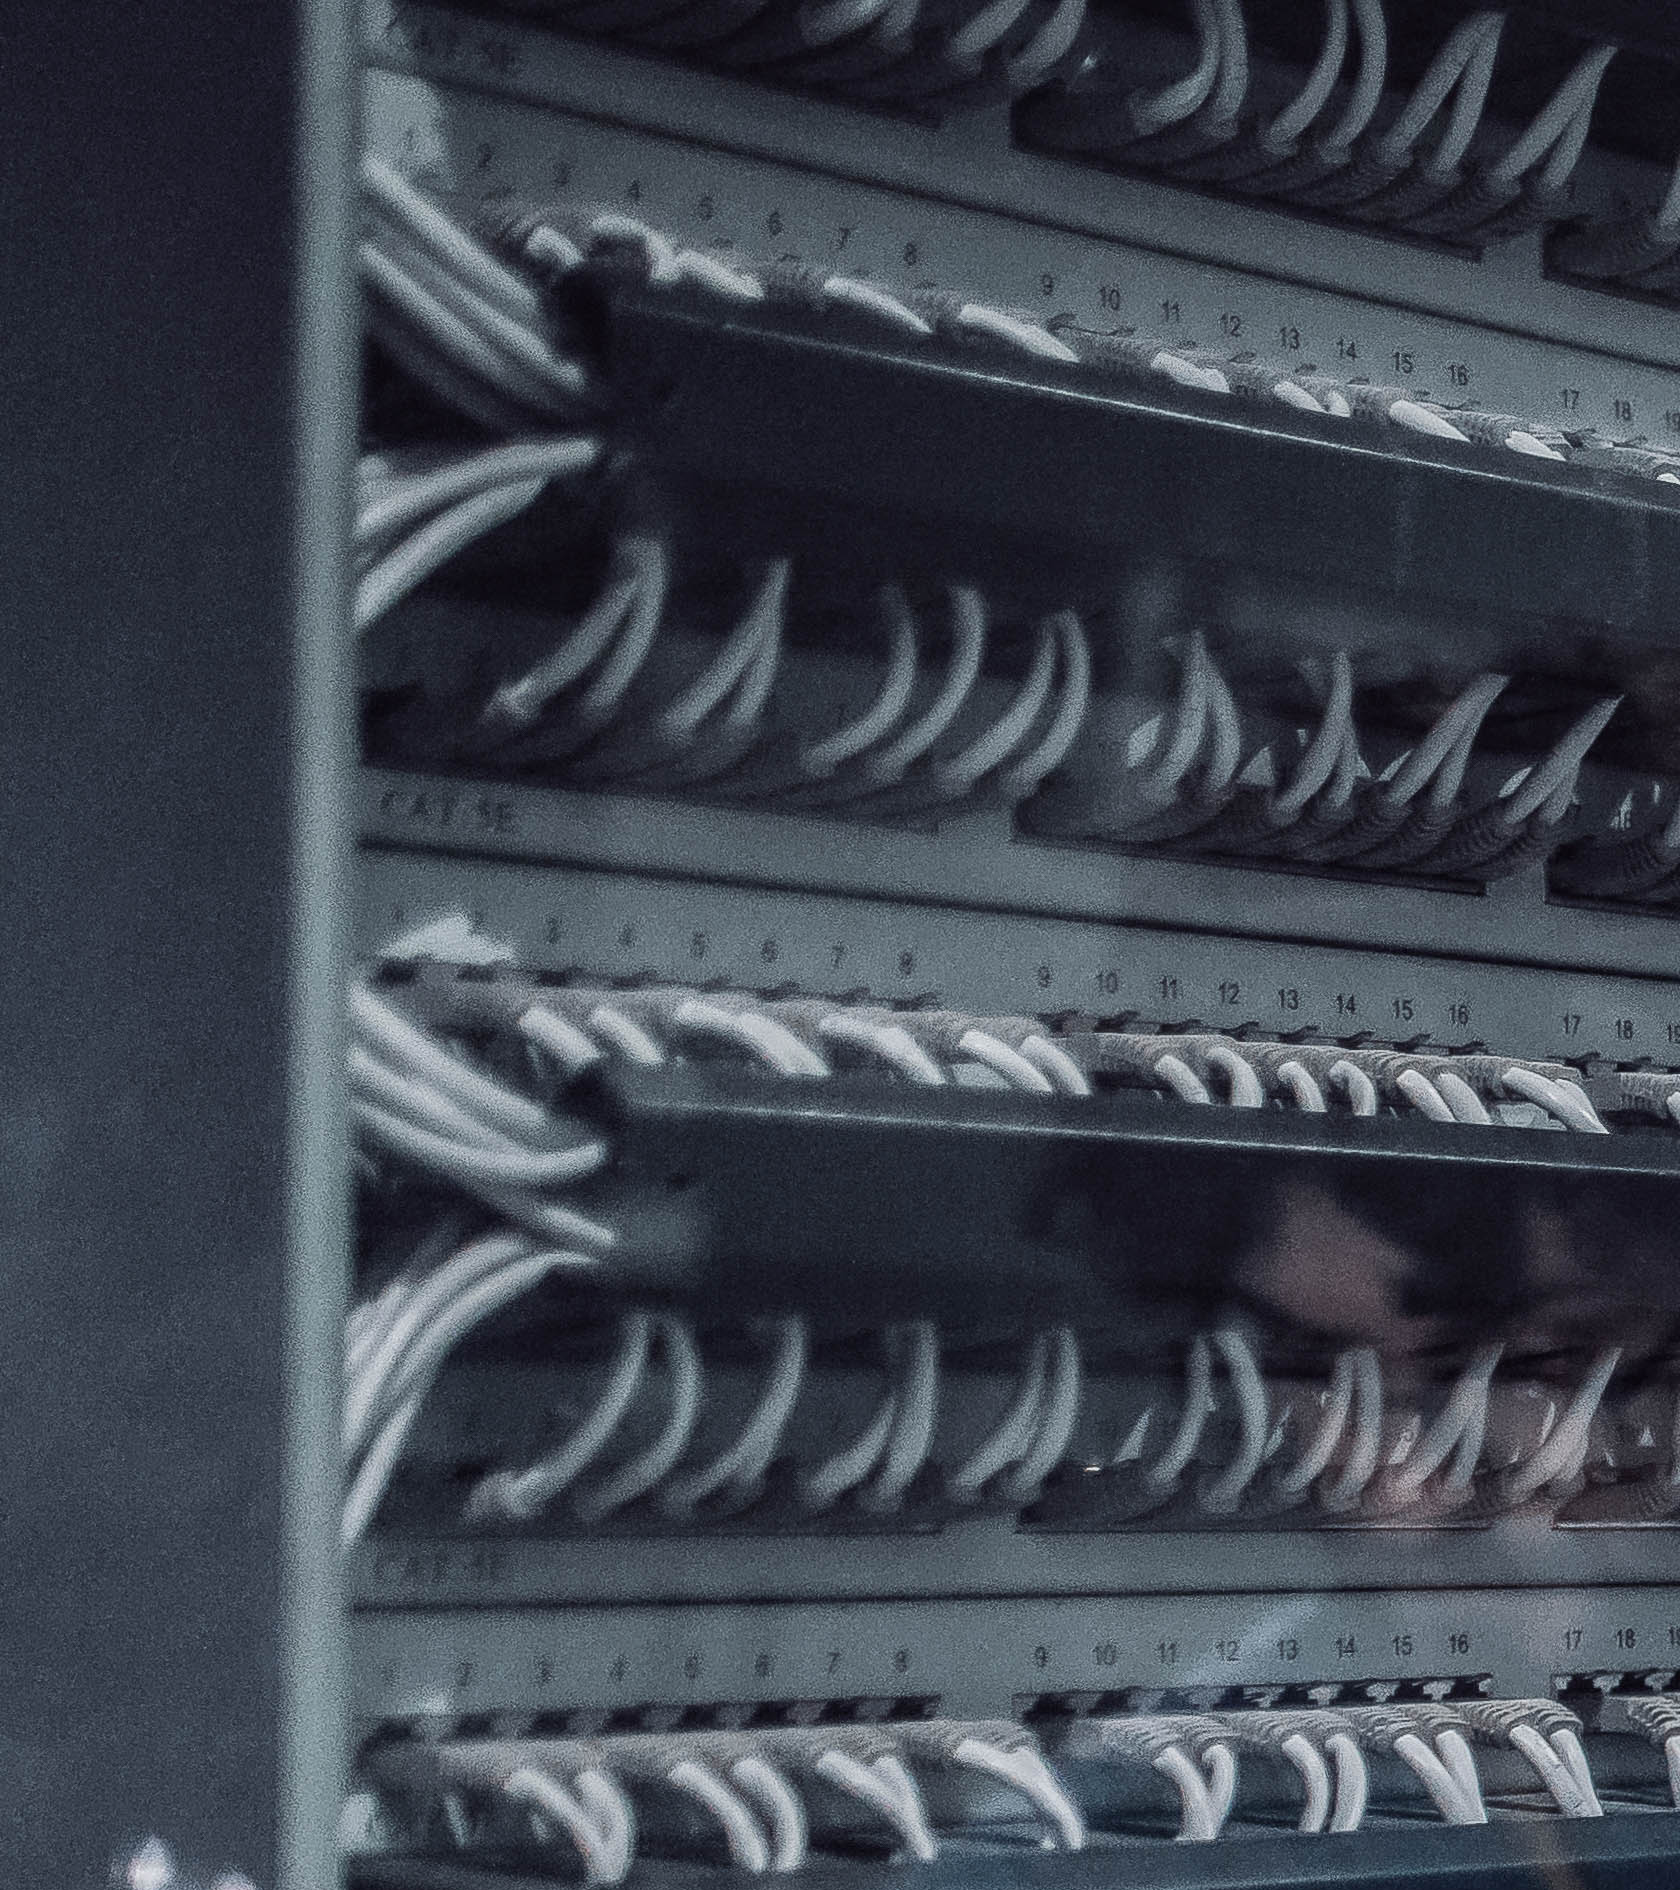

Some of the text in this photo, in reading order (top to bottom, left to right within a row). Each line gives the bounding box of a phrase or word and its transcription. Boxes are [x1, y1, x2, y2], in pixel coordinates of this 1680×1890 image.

[698, 195, 714, 221] 5
[766, 210, 783, 237] 6
[903, 242, 918, 267] 8
[1041, 273, 1054, 296] 9
[1099, 286, 1121, 312] 10
[1161, 300, 1180, 323] 11
[1220, 313, 1242, 338] 12
[1280, 326, 1301, 351] 13
[1337, 339, 1358, 360] 14
[1392, 351, 1414, 375] 15
[1448, 364, 1469, 387] 16
[1560, 388, 1581, 410] 17
[1613, 400, 1633, 423] 18
[760, 939, 777, 963] 6
[832, 945, 845, 969] 7
[900, 952, 914, 975] 8
[1037, 965, 1052, 988] 9
[1096, 970, 1119, 994] 10
[1160, 976, 1178, 998] 11
[1218, 982, 1240, 1005] 12
[1278, 989, 1299, 1010] 13
[1336, 994, 1356, 1014] 14
[1393, 999, 1414, 1021] 15
[1449, 1003, 1470, 1025] 16
[1563, 1014, 1582, 1036] 17
[1616, 1020, 1634, 1040] 18
[828, 1651, 841, 1673] 7
[895, 1650, 909, 1672] 8
[1034, 1645, 1048, 1668] 9
[1093, 1643, 1117, 1666] 10
[1157, 1642, 1177, 1663] 11
[1216, 1640, 1239, 1662] 12
[1277, 1638, 1300, 1660] 13
[1335, 1637, 1357, 1657] 14
[1392, 1634, 1413, 1656] 15
[1449, 1633, 1470, 1654] 16
[1564, 1629, 1583, 1649] 17
[1616, 1628, 1635, 1649] 18
